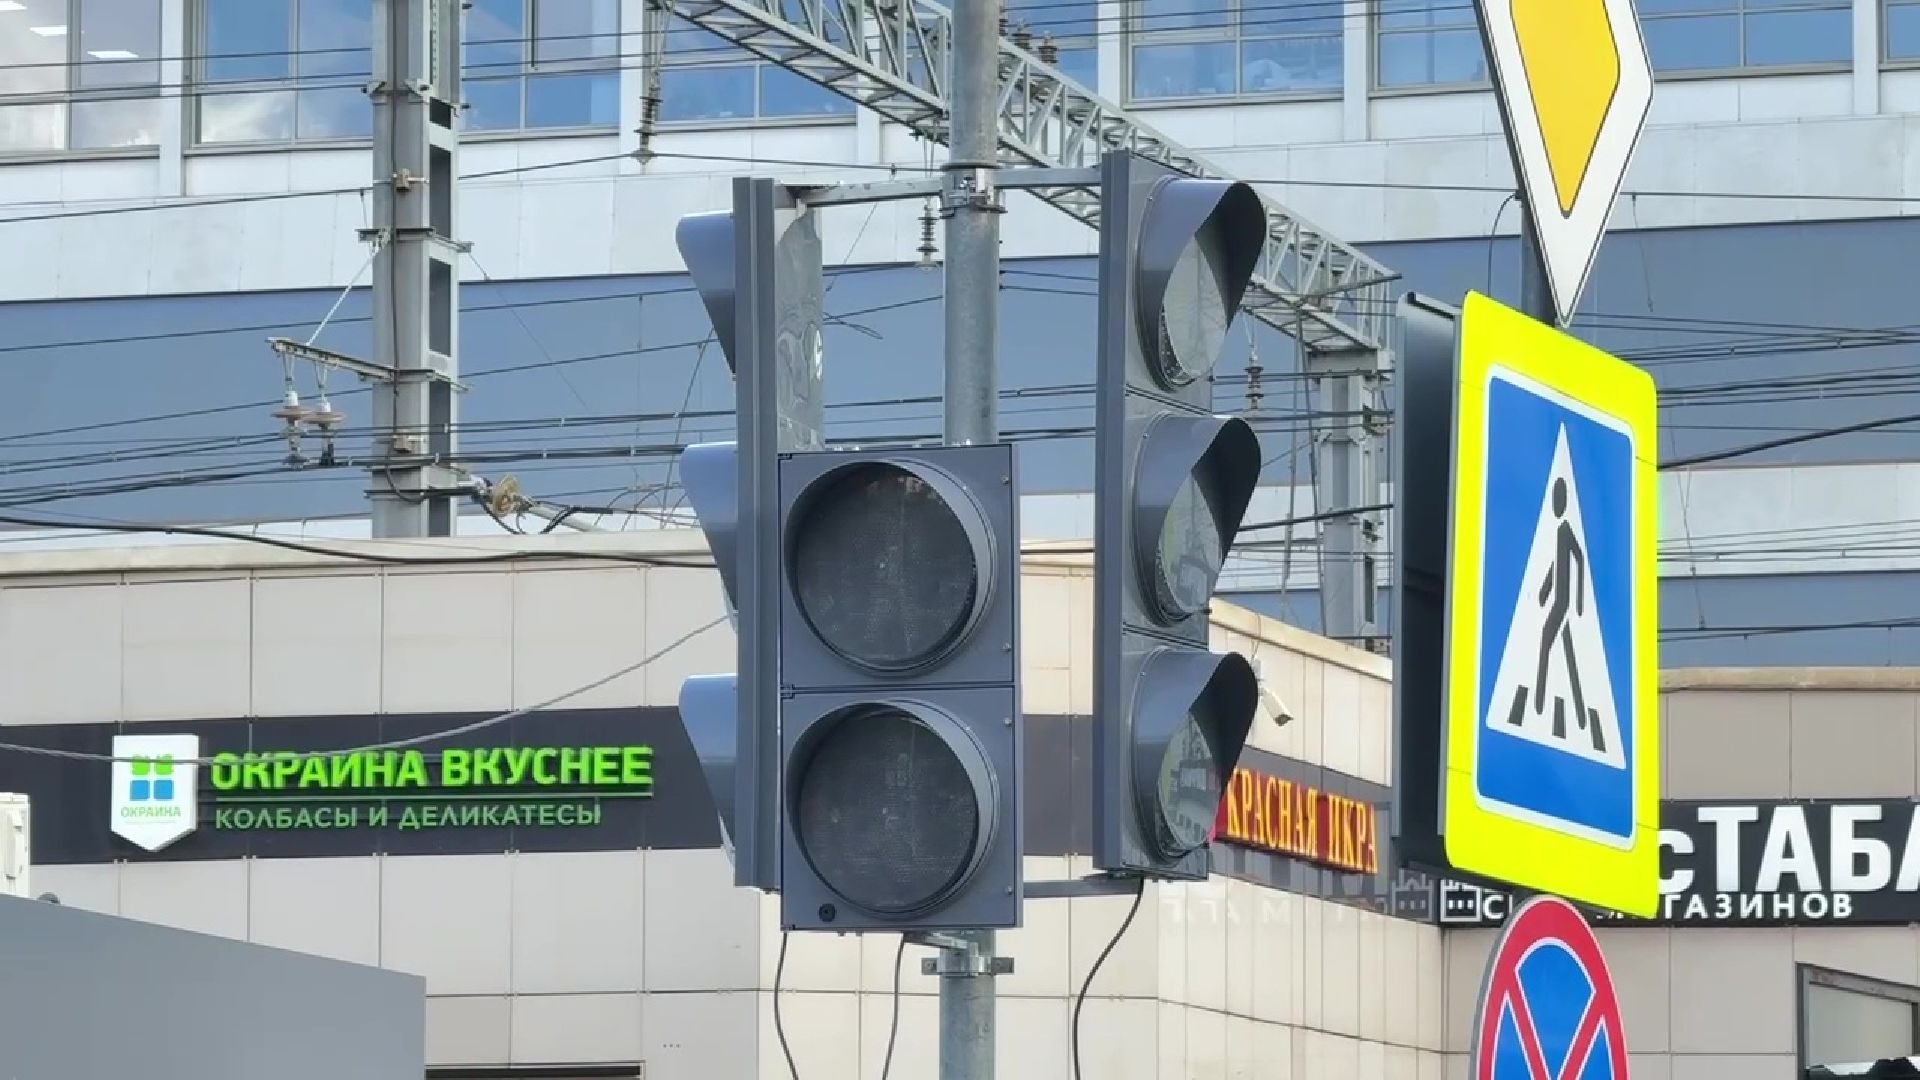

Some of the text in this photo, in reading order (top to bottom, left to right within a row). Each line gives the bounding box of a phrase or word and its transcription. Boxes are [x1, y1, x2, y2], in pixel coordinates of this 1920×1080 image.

[211, 746, 654, 790] ОКРАИНА ВКУСНЕЕ
[120, 806, 182, 818] ОКРАИНА
[215, 804, 601, 830] КОЛБАСЫ И ДЕЛИКАТЕСЫ
[1227, 768, 1318, 858] КРАСНАЯ
[1658, 804, 1920, 894] сТАБ
[1609, 893, 1853, 920] ГАЗИНОВ
